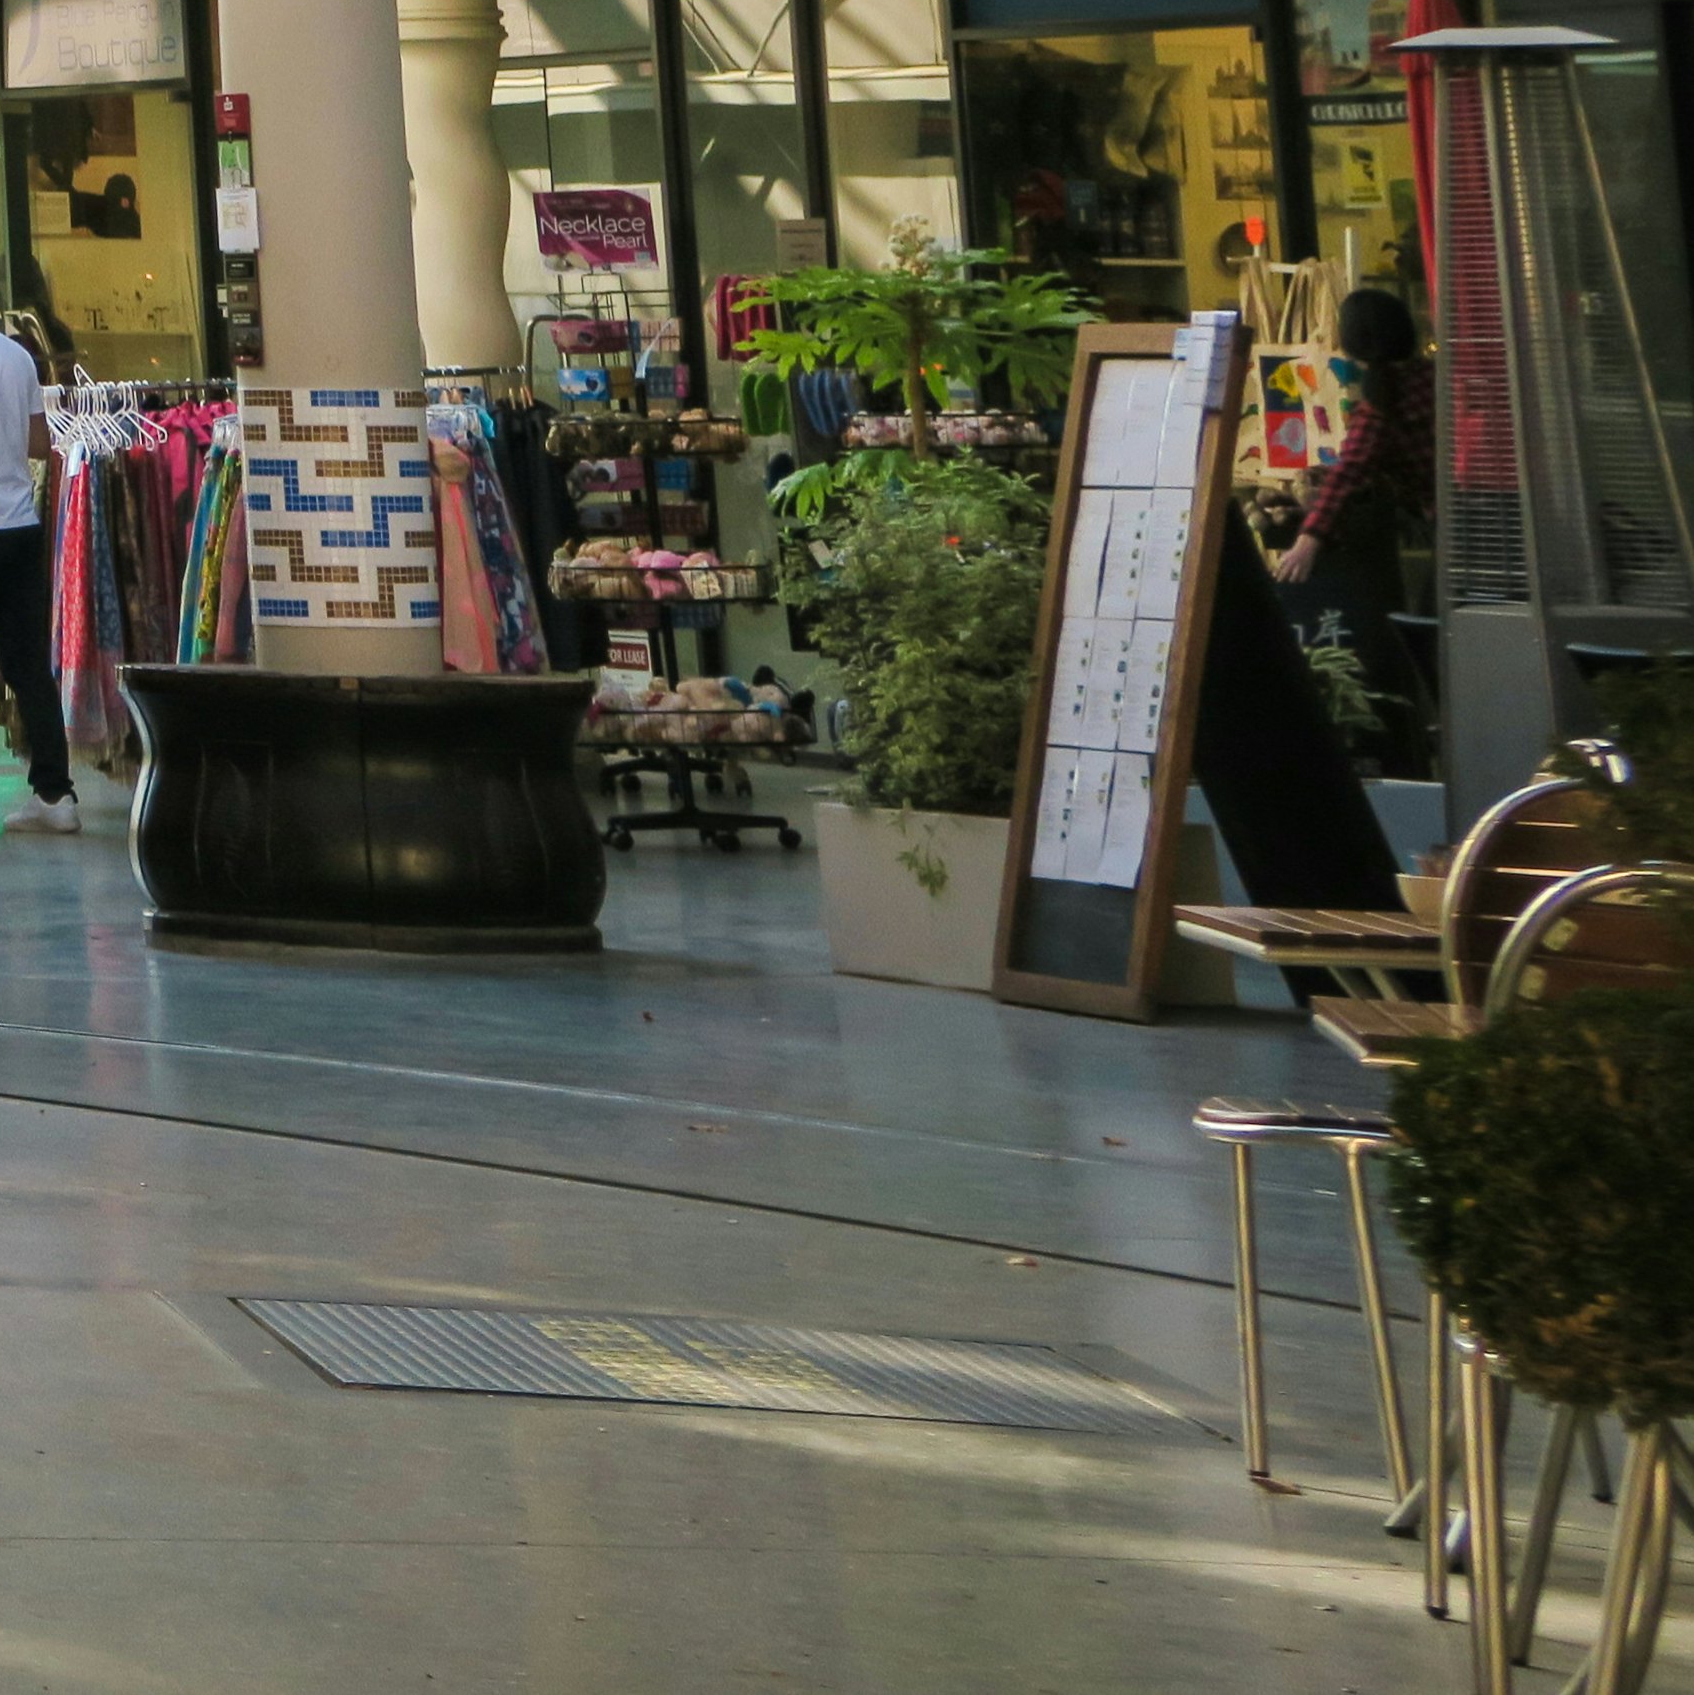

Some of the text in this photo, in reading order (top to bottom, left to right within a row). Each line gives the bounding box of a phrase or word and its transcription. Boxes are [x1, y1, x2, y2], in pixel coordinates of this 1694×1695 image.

[104, 0, 175, 29] Pengun
[57, 35, 177, 74] Boutique
[539, 214, 647, 236] Necklace
[602, 232, 649, 249] Pearl
